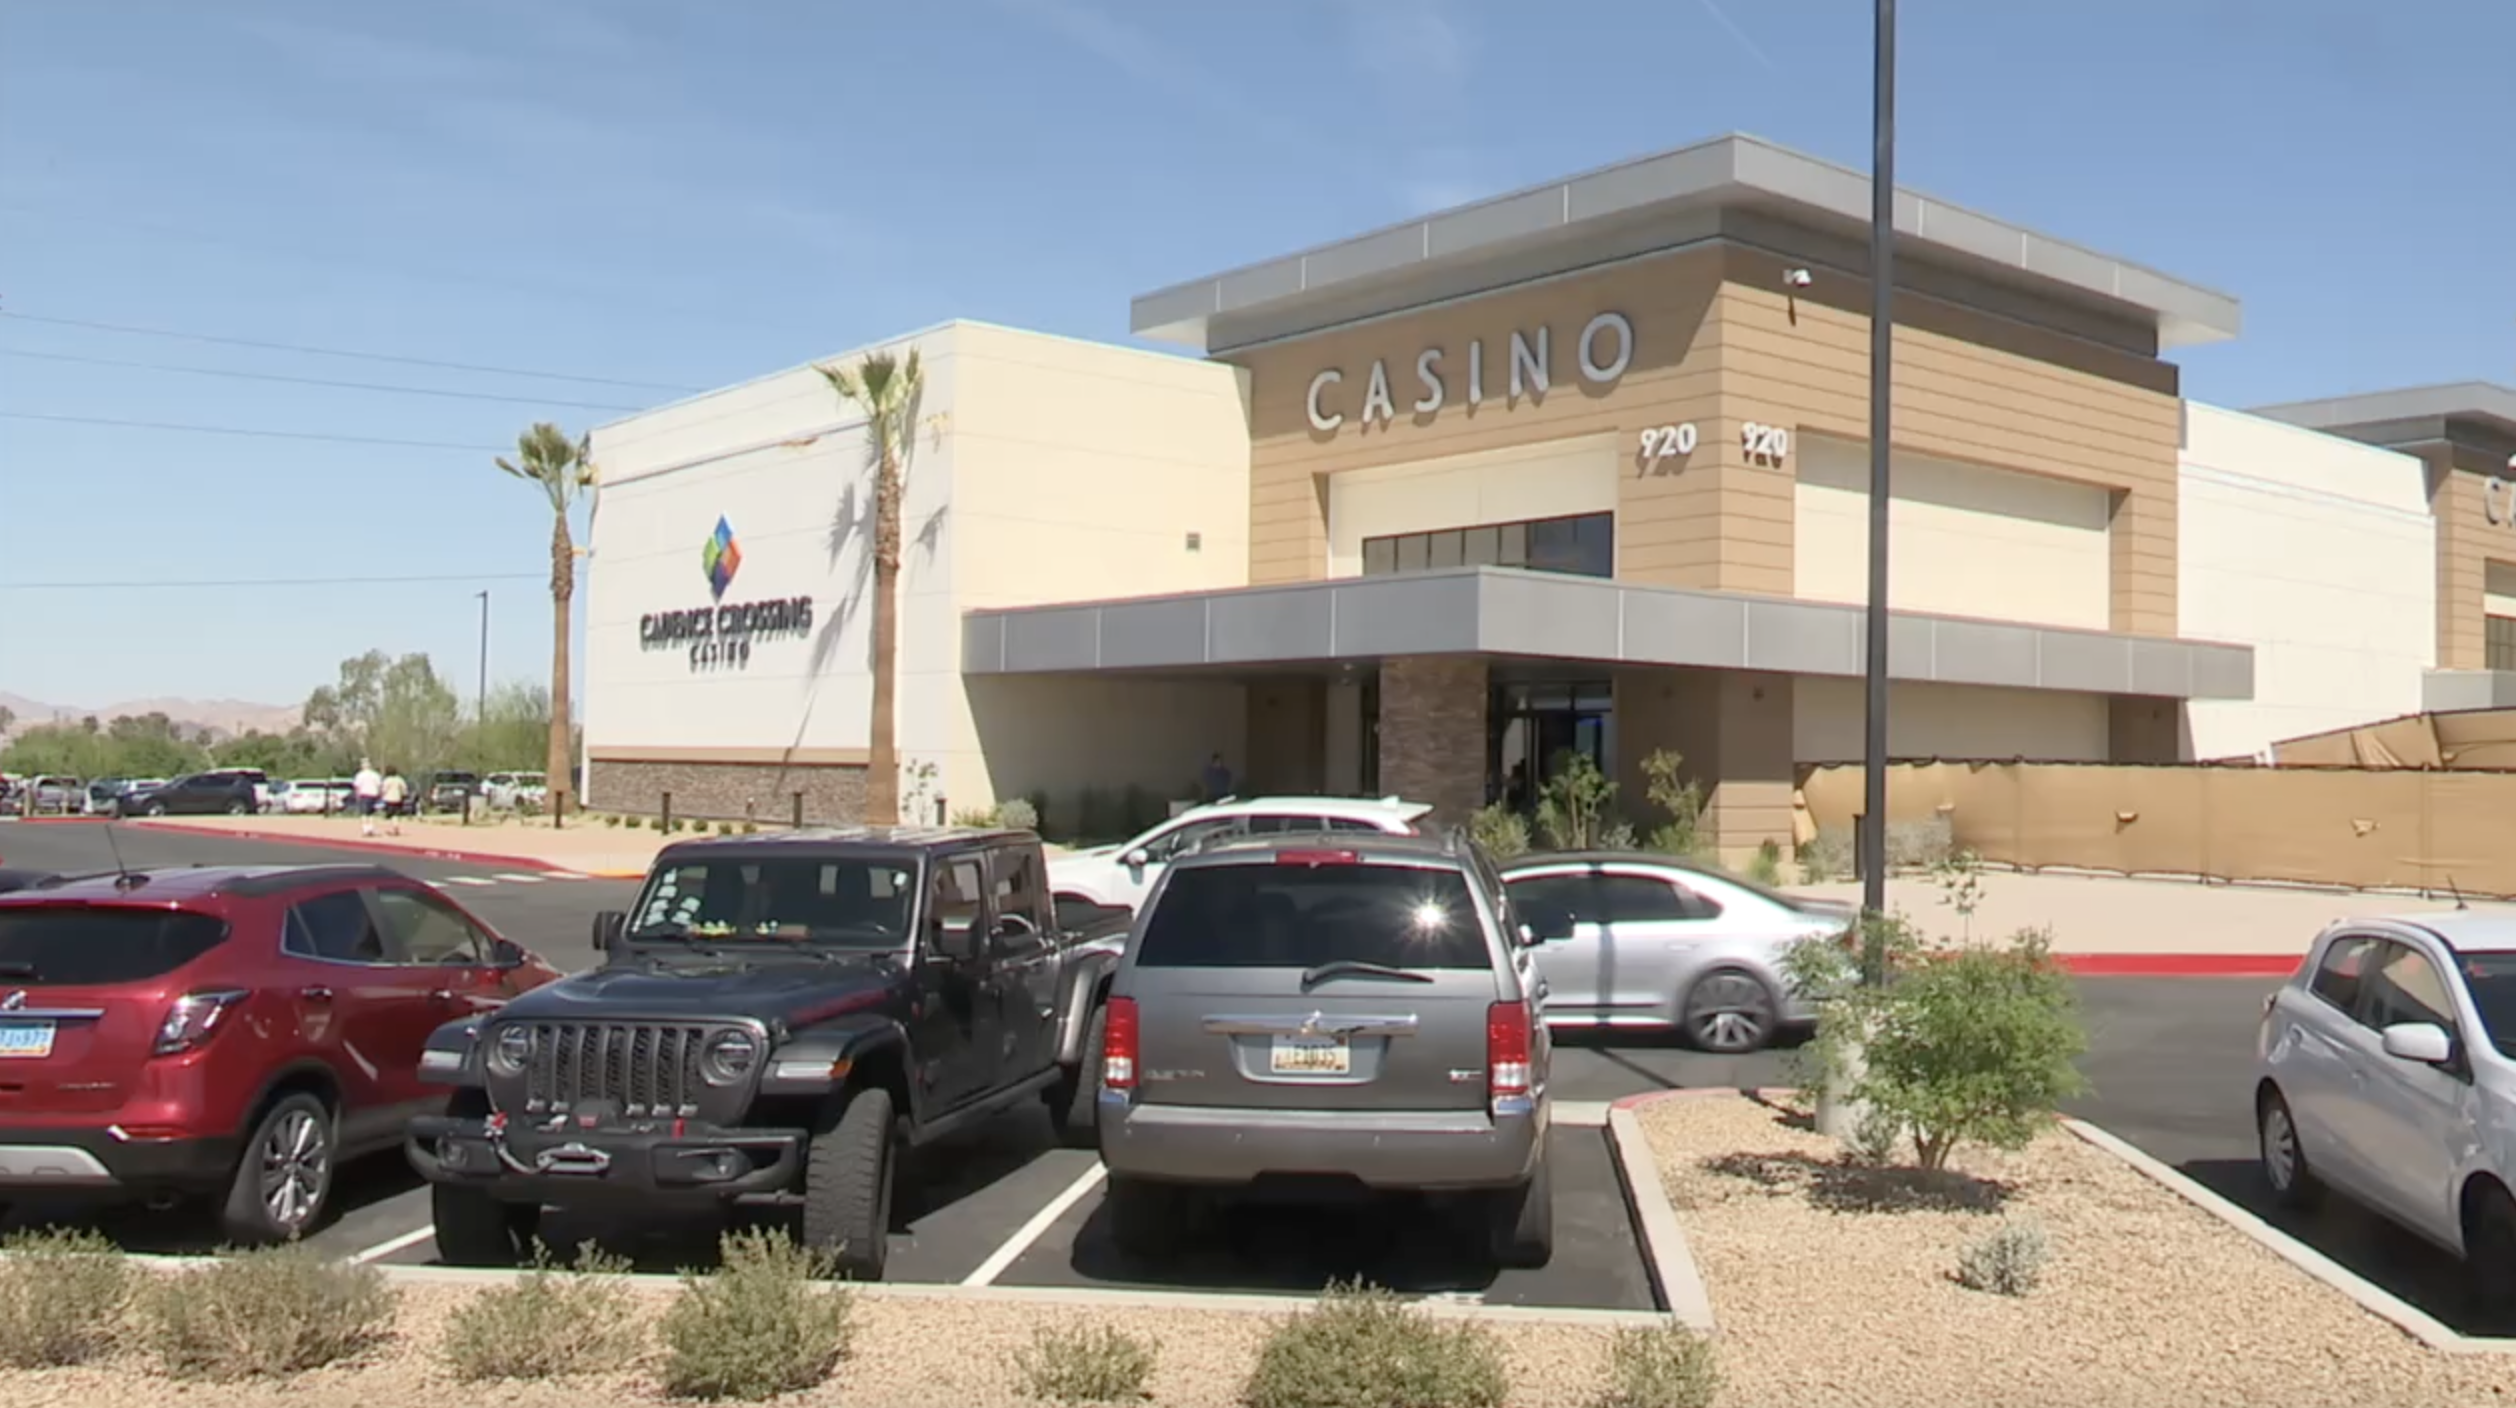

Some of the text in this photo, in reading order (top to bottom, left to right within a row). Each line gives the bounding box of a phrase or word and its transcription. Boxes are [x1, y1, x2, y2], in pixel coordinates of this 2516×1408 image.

[1306, 312, 1633, 431] CASINO
[1641, 422, 1697, 458] 920
[1742, 421, 1788, 458] 920
[2484, 476, 2516, 522] C
[717, 596, 813, 635] CROSSING
[690, 641, 750, 664] CASINO
